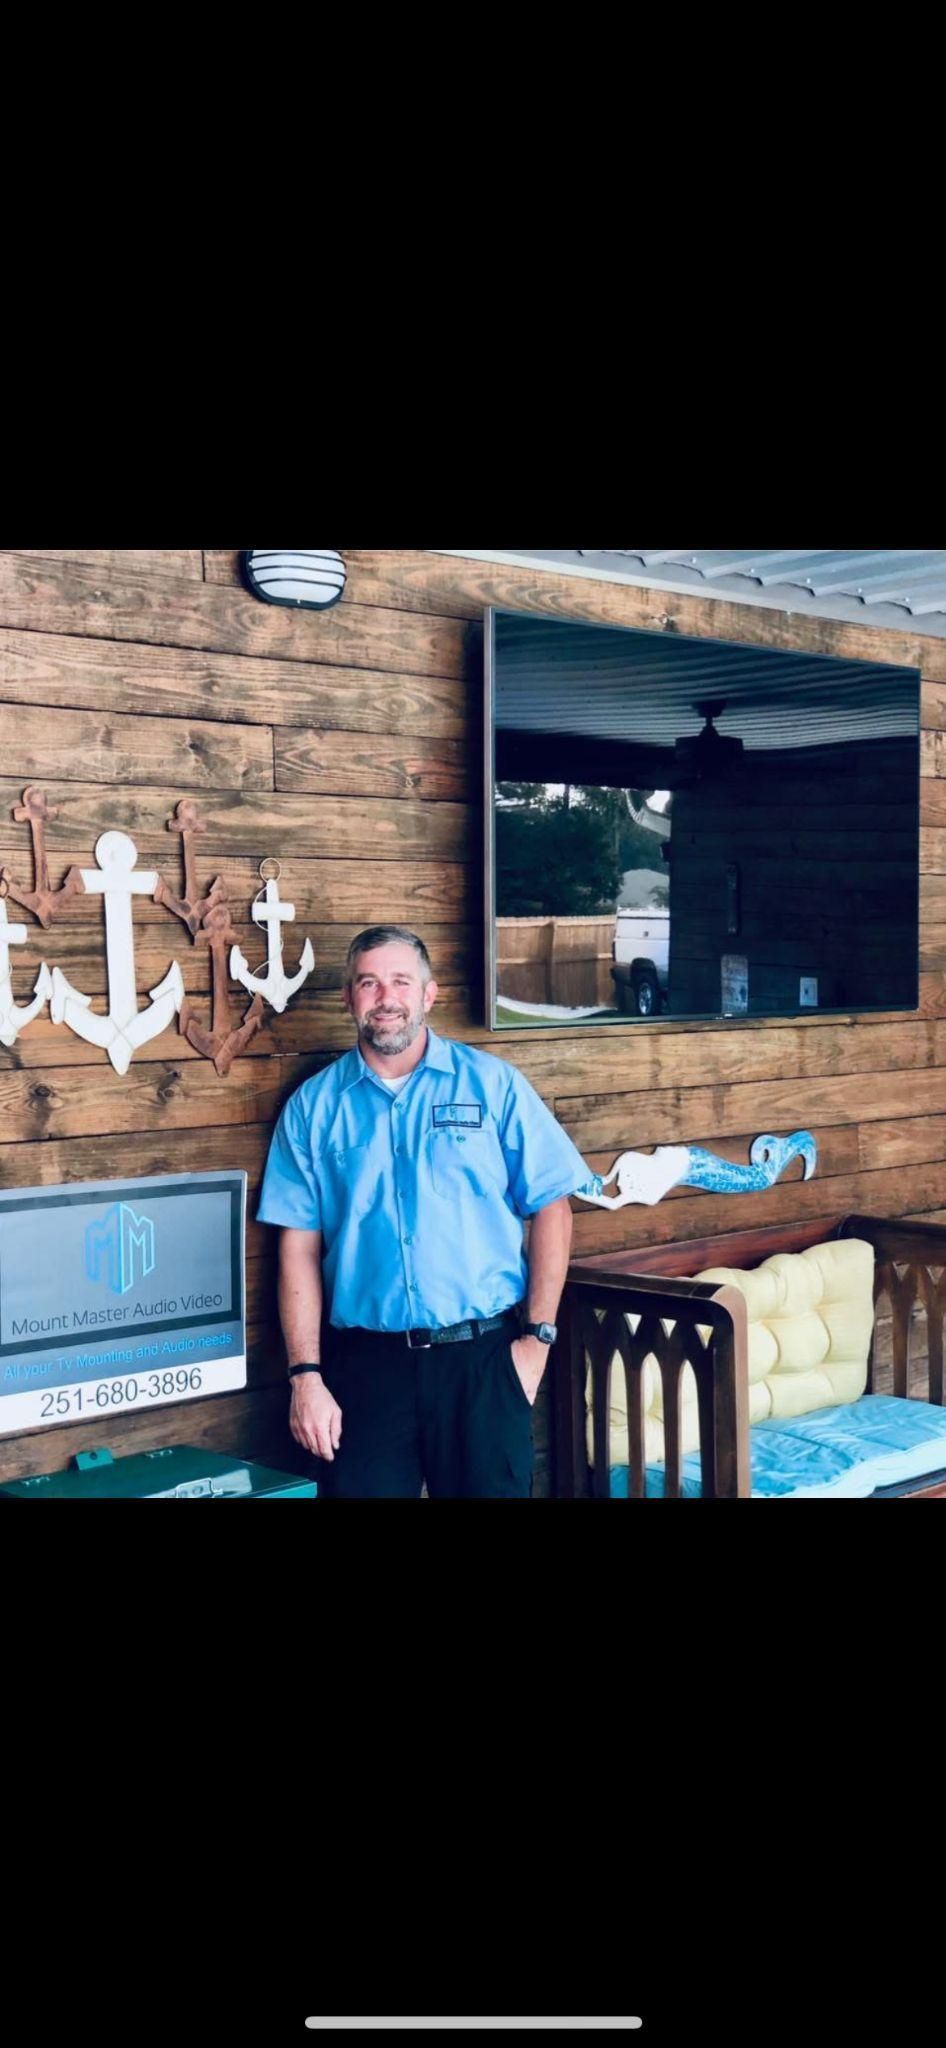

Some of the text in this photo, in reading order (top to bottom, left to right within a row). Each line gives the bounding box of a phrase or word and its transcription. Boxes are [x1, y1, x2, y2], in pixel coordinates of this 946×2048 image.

[11, 1293, 223, 1336] Mount Master Audio Video
[3, 1364, 22, 1380] All
[24, 1361, 53, 1378] your
[76, 1347, 133, 1368] Mounting
[136, 1343, 158, 1358] and
[162, 1337, 196, 1354] Audio
[198, 1331, 233, 1348] needs
[40, 1367, 202, 1418] 251-680-3896
